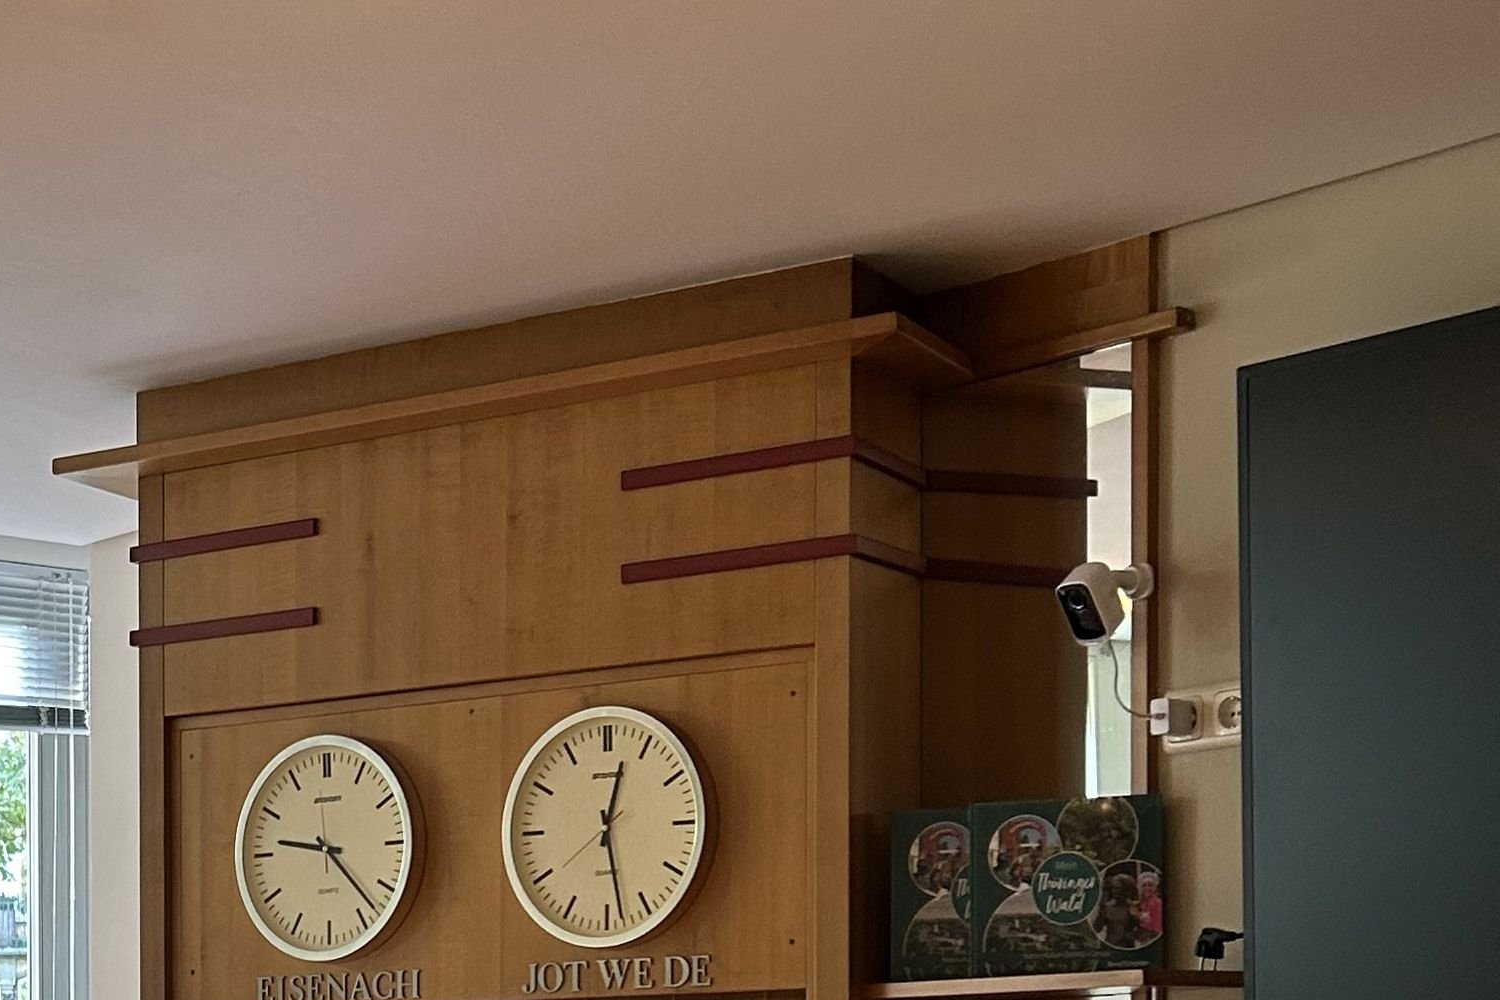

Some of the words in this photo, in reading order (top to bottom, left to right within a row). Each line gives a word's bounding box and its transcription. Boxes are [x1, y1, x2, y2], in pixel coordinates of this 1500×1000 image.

[521, 960, 589, 995] JOT
[596, 956, 653, 991] WE
[663, 953, 713, 988] DE
